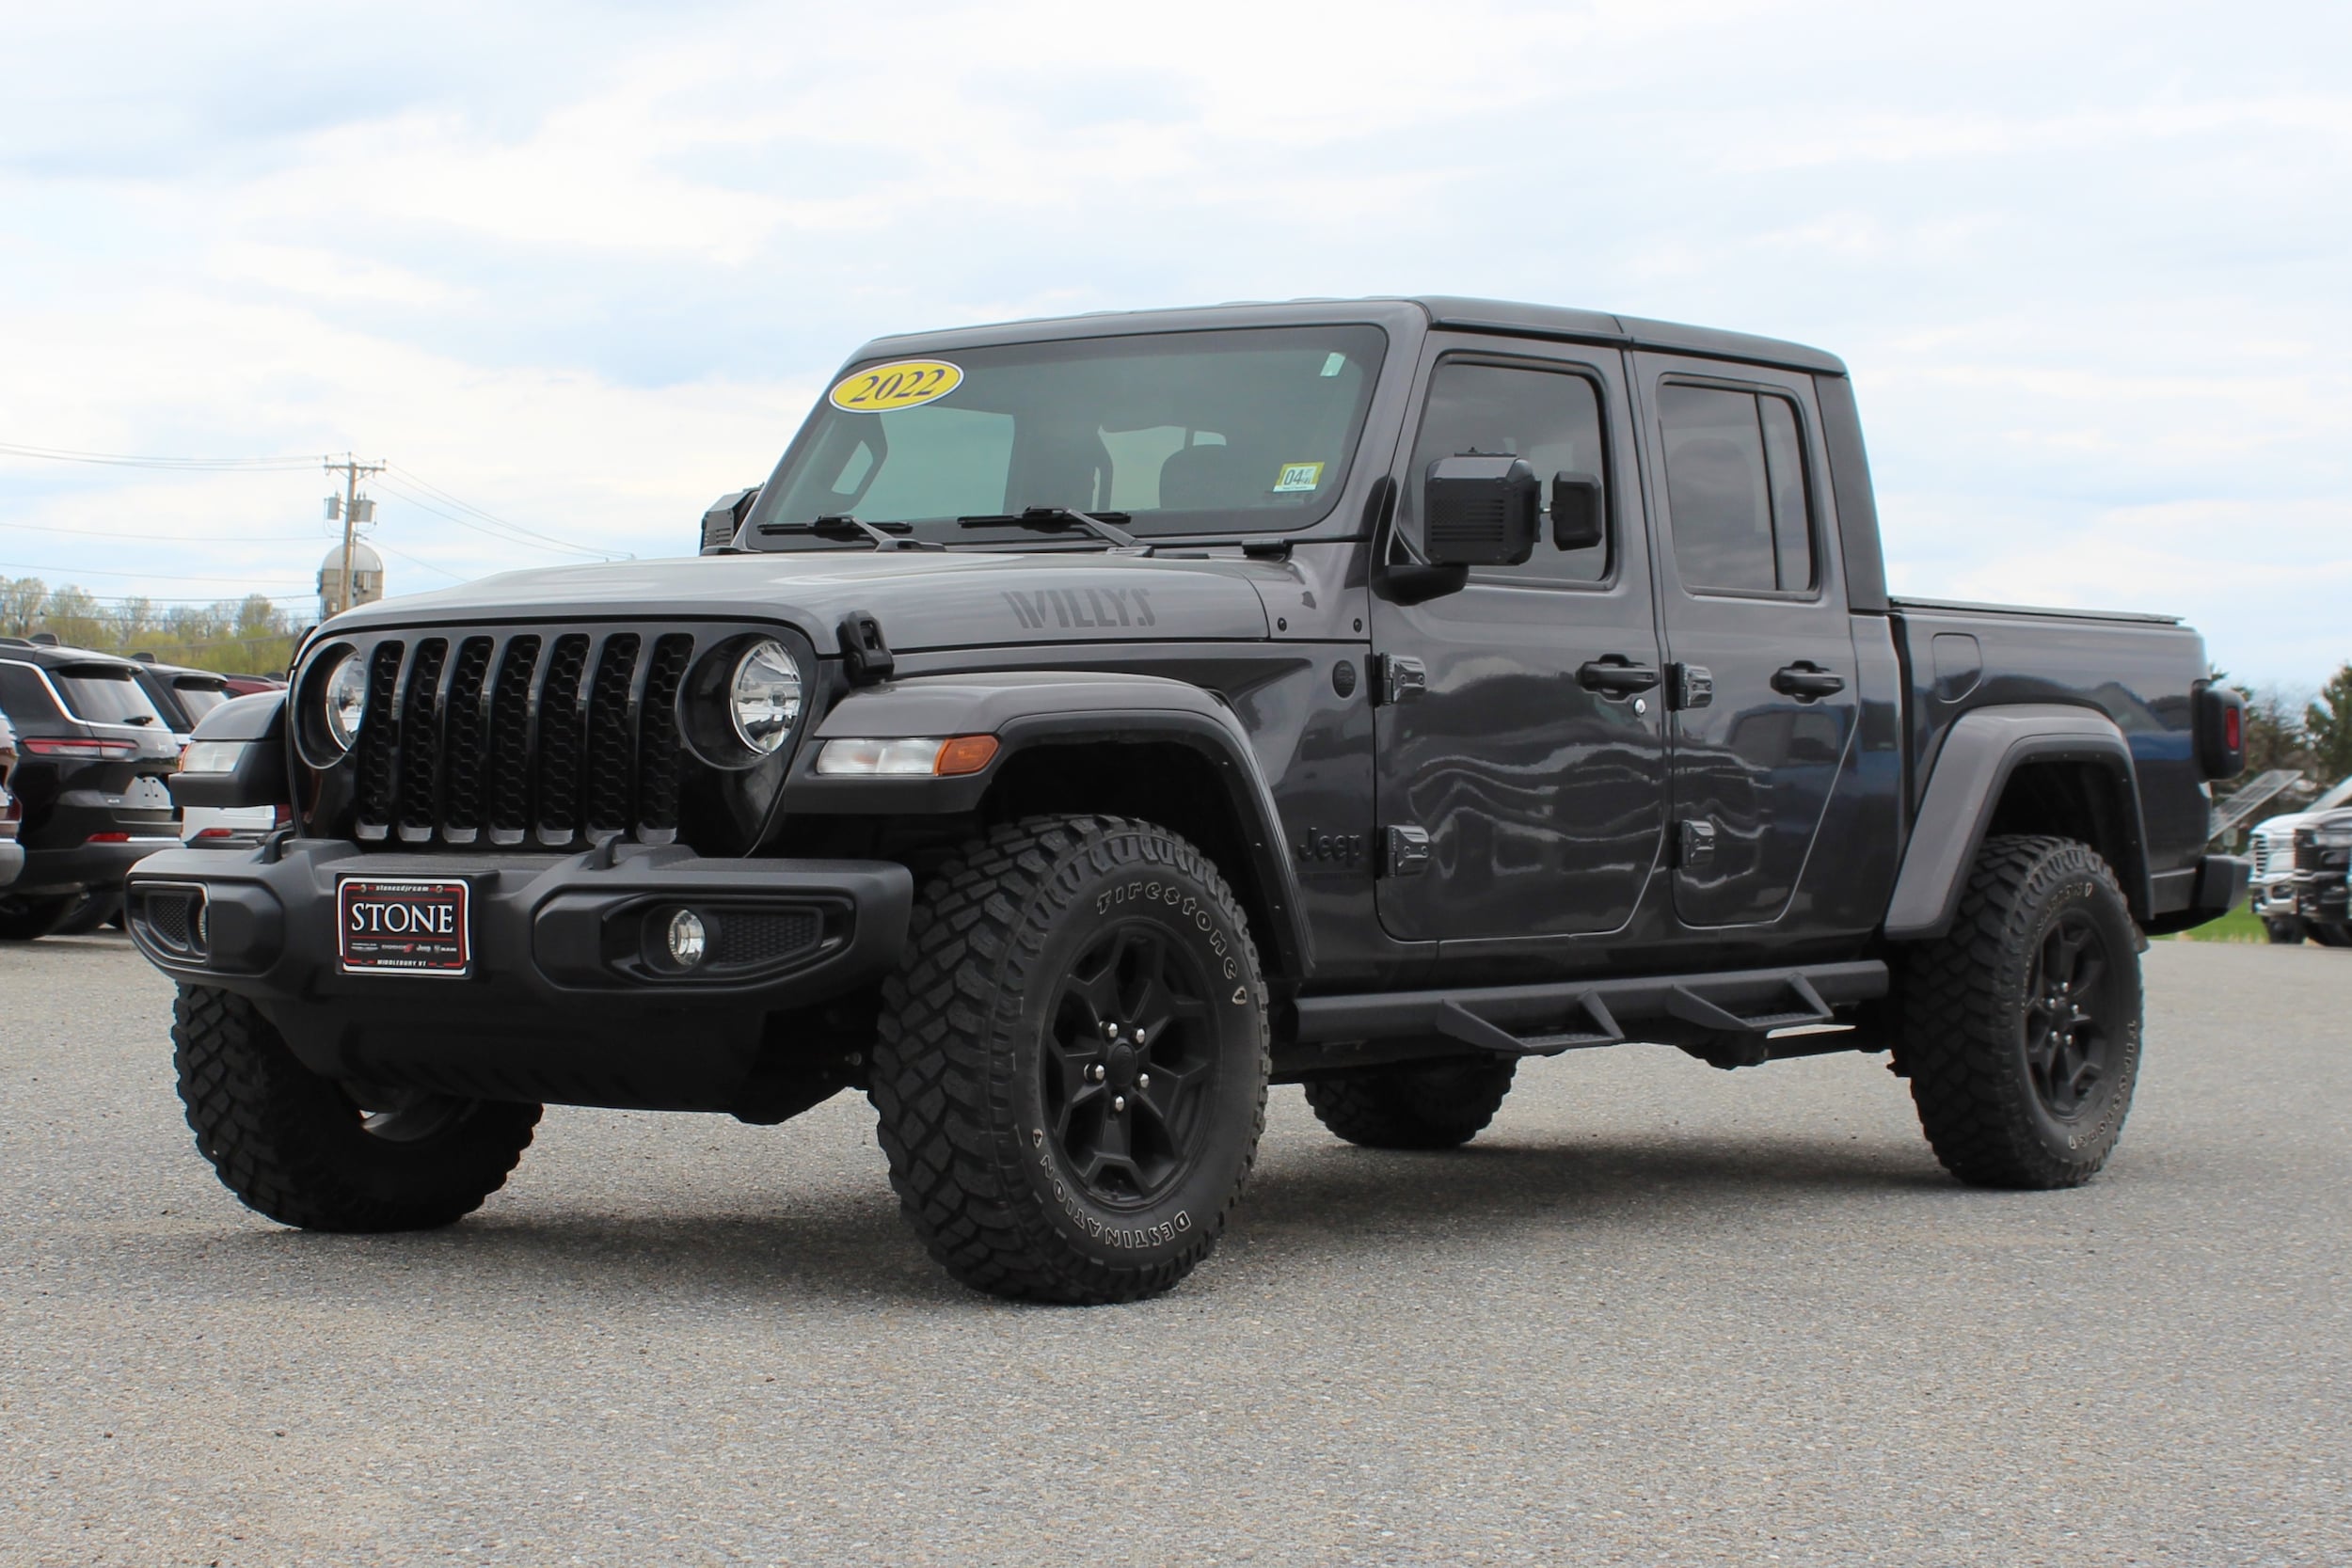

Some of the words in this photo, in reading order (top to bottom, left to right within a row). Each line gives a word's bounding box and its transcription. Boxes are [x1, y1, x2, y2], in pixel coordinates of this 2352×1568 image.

[849, 369, 946, 403] 2022
[1283, 468, 1304, 485] 04
[1000, 588, 1156, 628] WILLYS
[1298, 827, 1360, 867] Jeep
[351, 903, 453, 933] STONE
[1097, 881, 1237, 979] Firestone
[1040, 1154, 1192, 1248] DESTINATION
